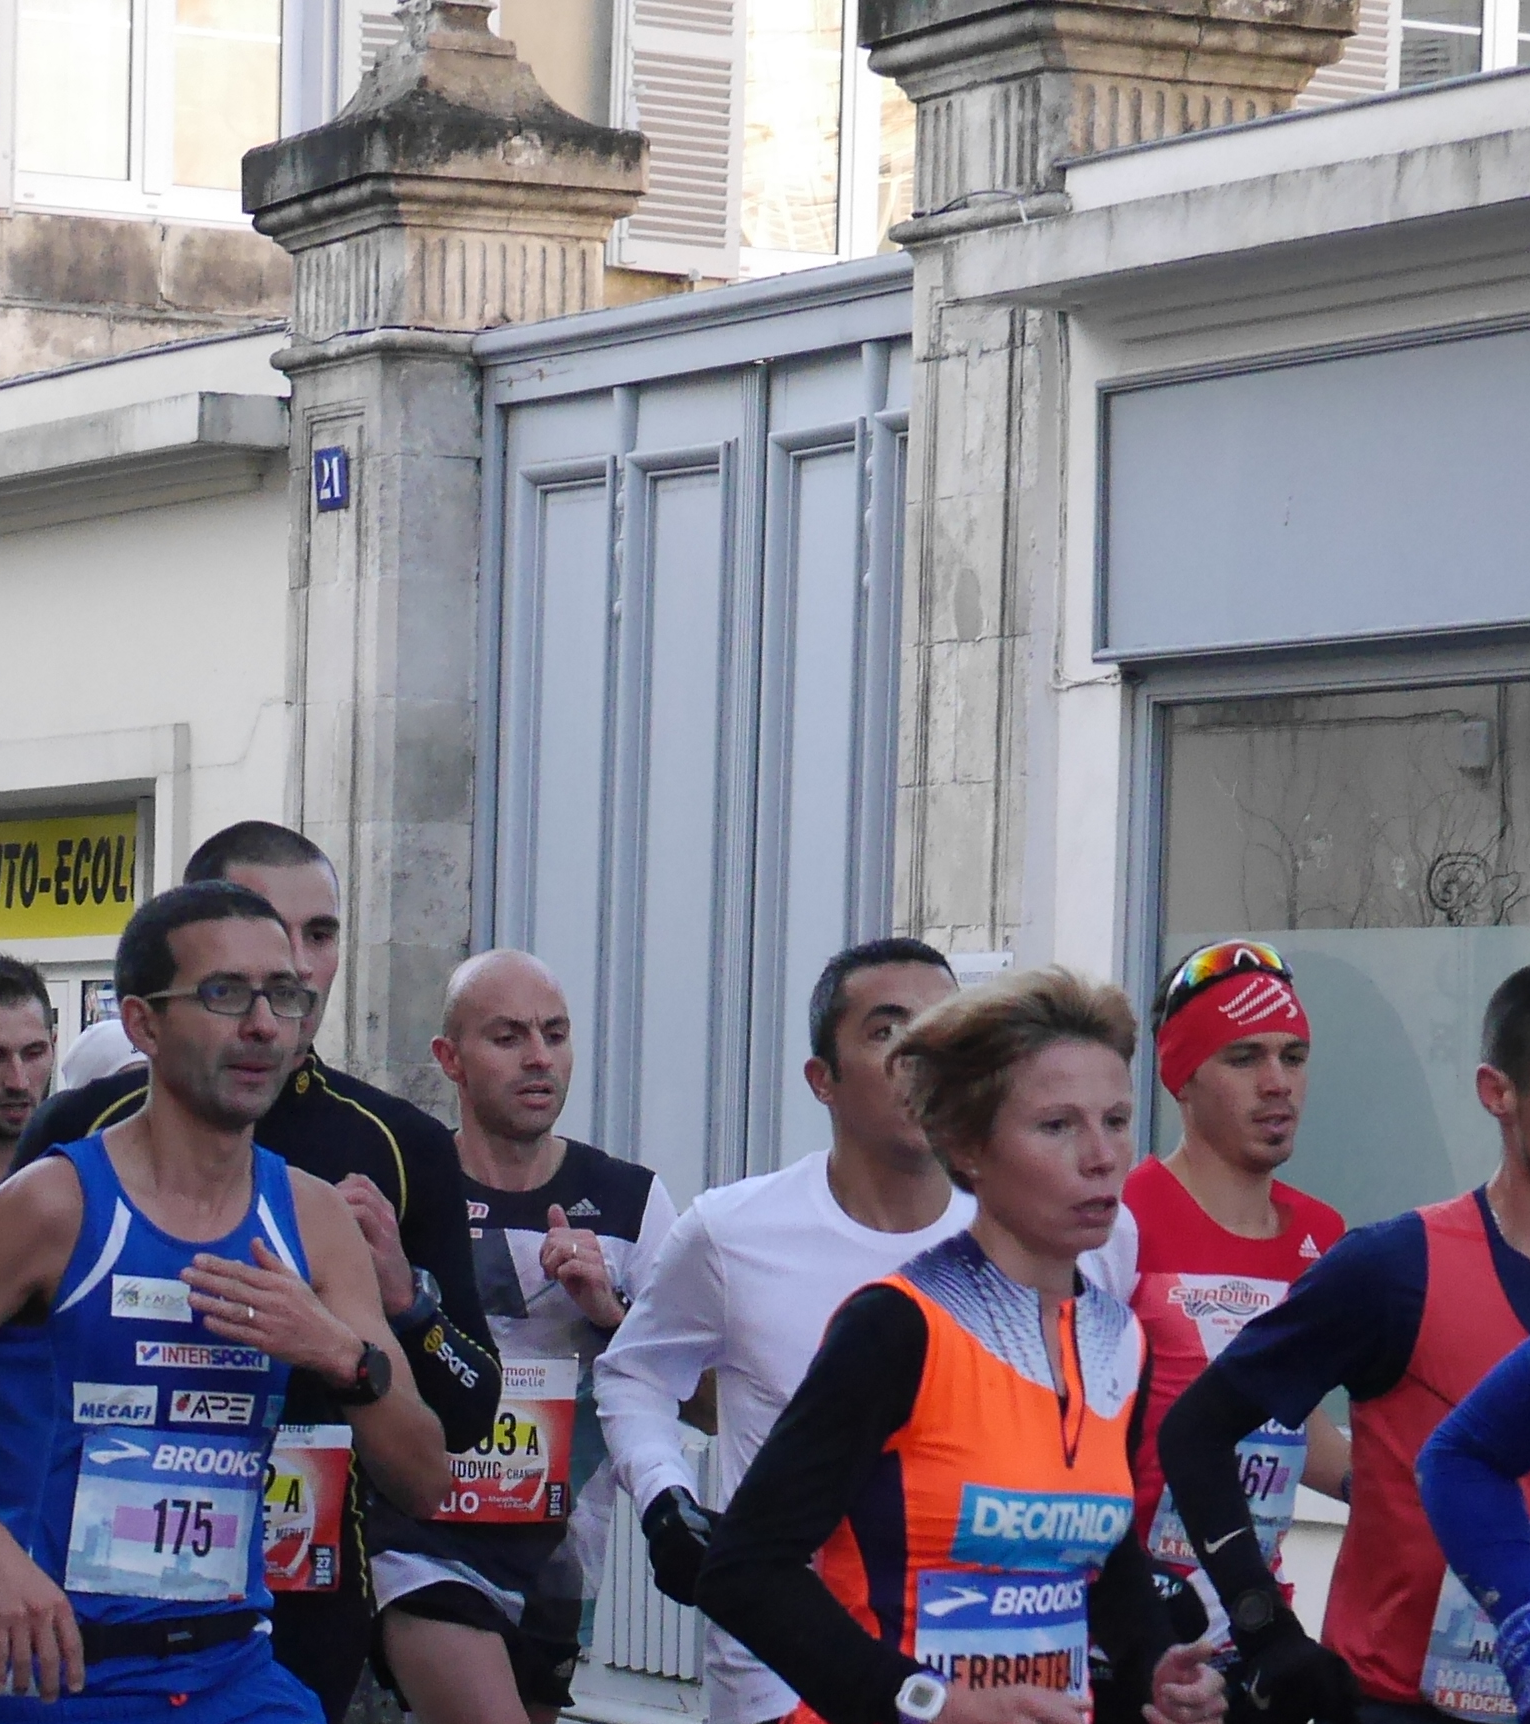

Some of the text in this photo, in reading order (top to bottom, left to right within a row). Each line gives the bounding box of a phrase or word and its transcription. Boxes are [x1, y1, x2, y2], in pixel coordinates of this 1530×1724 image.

[320, 455, 342, 500] 21
[1171, 1288, 1270, 1306] STADIUM
[162, 1346, 264, 1369] INTERSPORT
[79, 1401, 154, 1420] MECAFI
[190, 1394, 251, 1421] APE
[526, 1425, 539, 1456] A
[153, 1444, 260, 1476] BROOKS
[283, 1478, 301, 1514] A
[153, 1497, 214, 1559] 175
[973, 1496, 1131, 1543] DECATHLON
[315, 1557, 332, 1569] 27
[991, 1580, 1085, 1616] BROOKS
[1435, 1688, 1455, 1709] LA
